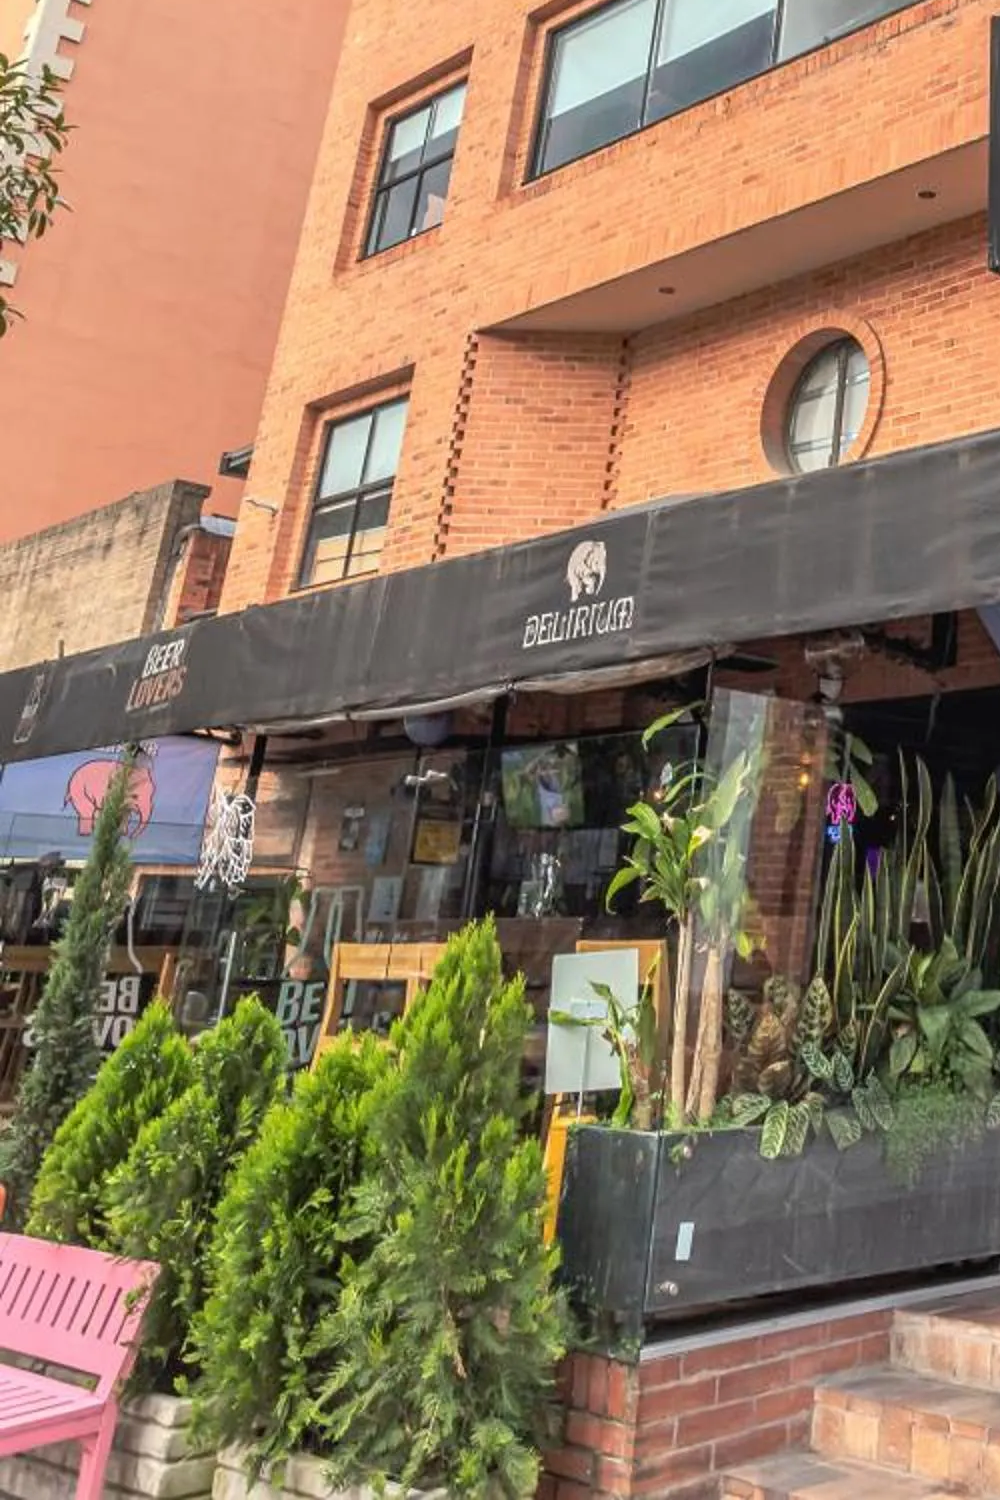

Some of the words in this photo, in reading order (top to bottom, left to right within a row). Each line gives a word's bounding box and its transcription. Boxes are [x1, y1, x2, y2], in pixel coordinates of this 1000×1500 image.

[522, 596, 635, 649] DELIRIUM
[141, 638, 185, 678] BEER
[125, 665, 188, 713] LOVERS
